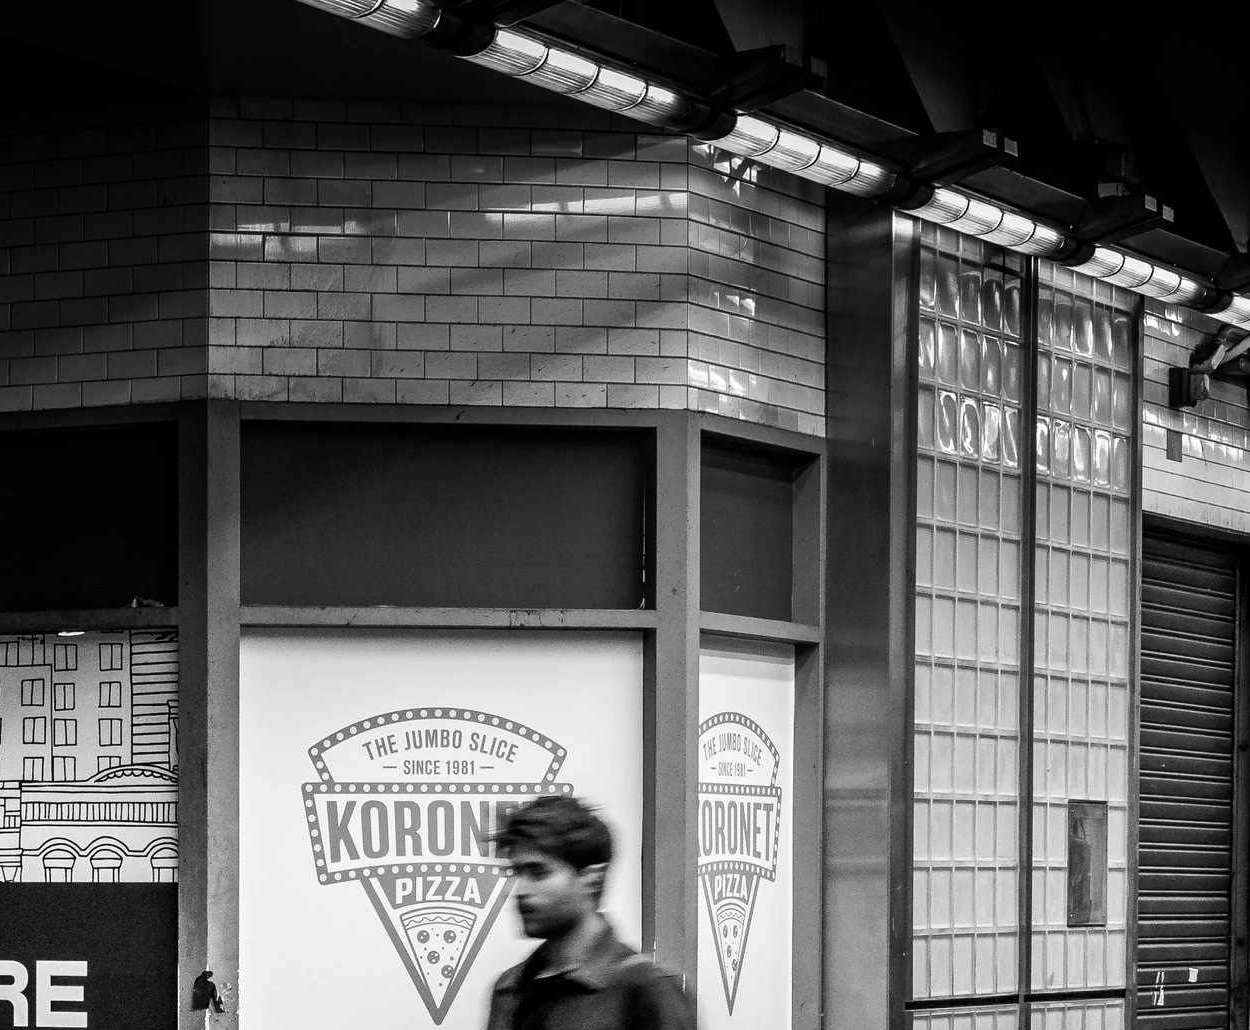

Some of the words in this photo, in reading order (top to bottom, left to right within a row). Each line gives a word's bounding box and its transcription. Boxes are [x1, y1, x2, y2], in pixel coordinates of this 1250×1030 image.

[362, 734, 399, 761] THE
[404, 729, 463, 751] JUMBO
[469, 732, 519, 764] SLICE
[703, 736, 717, 762] THE
[718, 732, 742, 754] JUMBO
[743, 736, 763, 767] SLICE
[403, 760, 441, 775] SINCE
[445, 760, 475, 775] 1981
[718, 761, 733, 777] SINCE
[734, 763, 746, 777] 1981
[699, 799, 774, 863] ORONET
[395, 876, 482, 904] PIZZA
[714, 873, 748, 900] PIZZA
